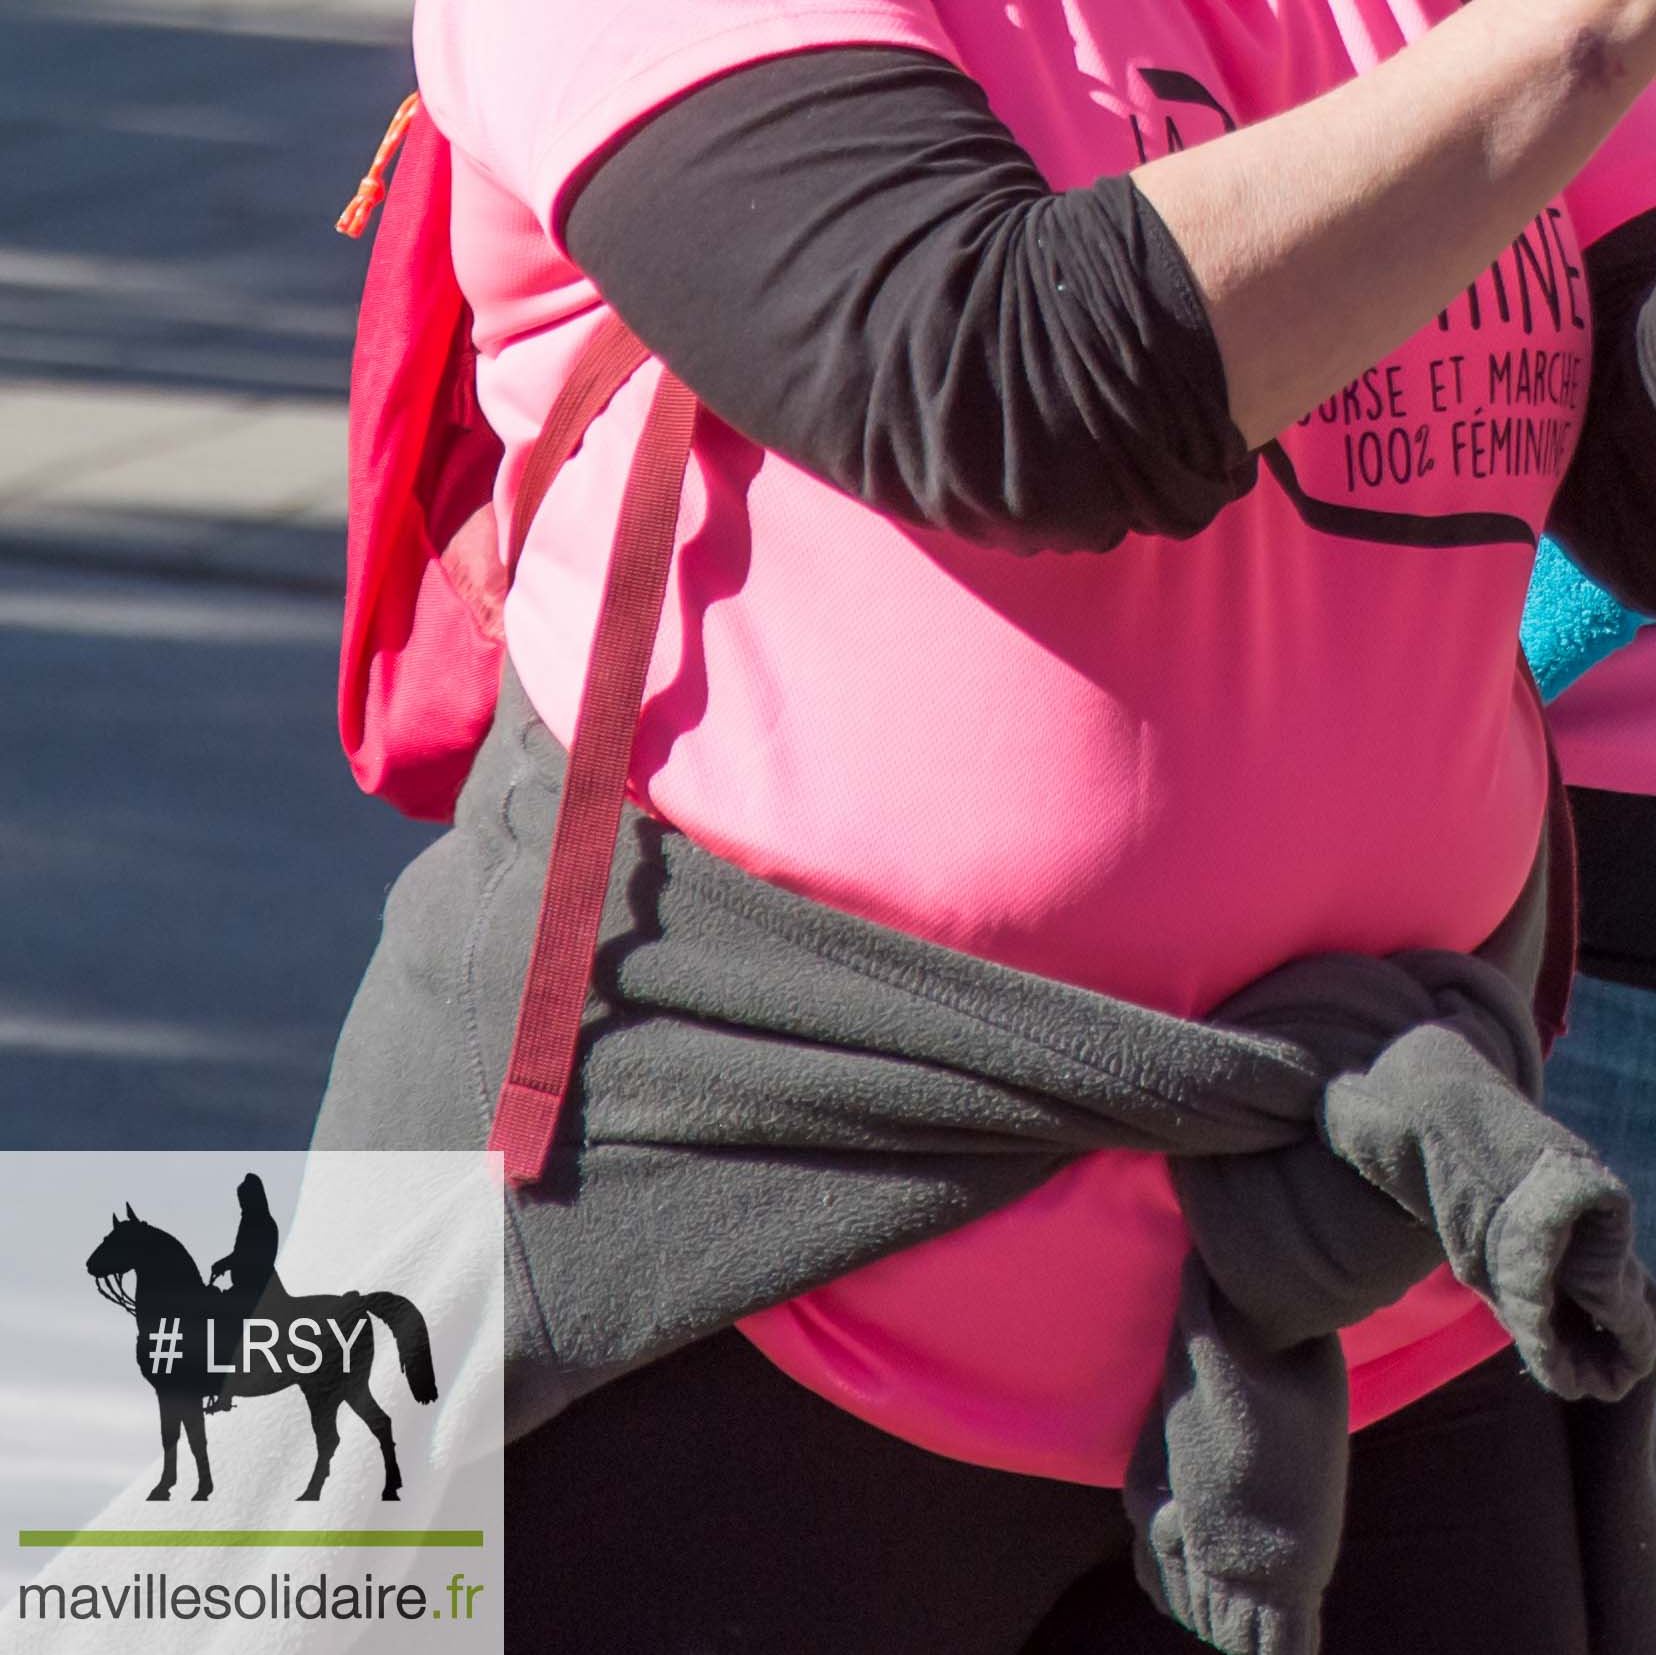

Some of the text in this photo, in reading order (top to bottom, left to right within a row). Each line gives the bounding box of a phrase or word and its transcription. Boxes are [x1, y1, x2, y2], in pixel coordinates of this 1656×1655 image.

[1430, 355, 1465, 413] ET
[1489, 347, 1582, 410] MARCHE
[1345, 424, 1434, 493] 100%
